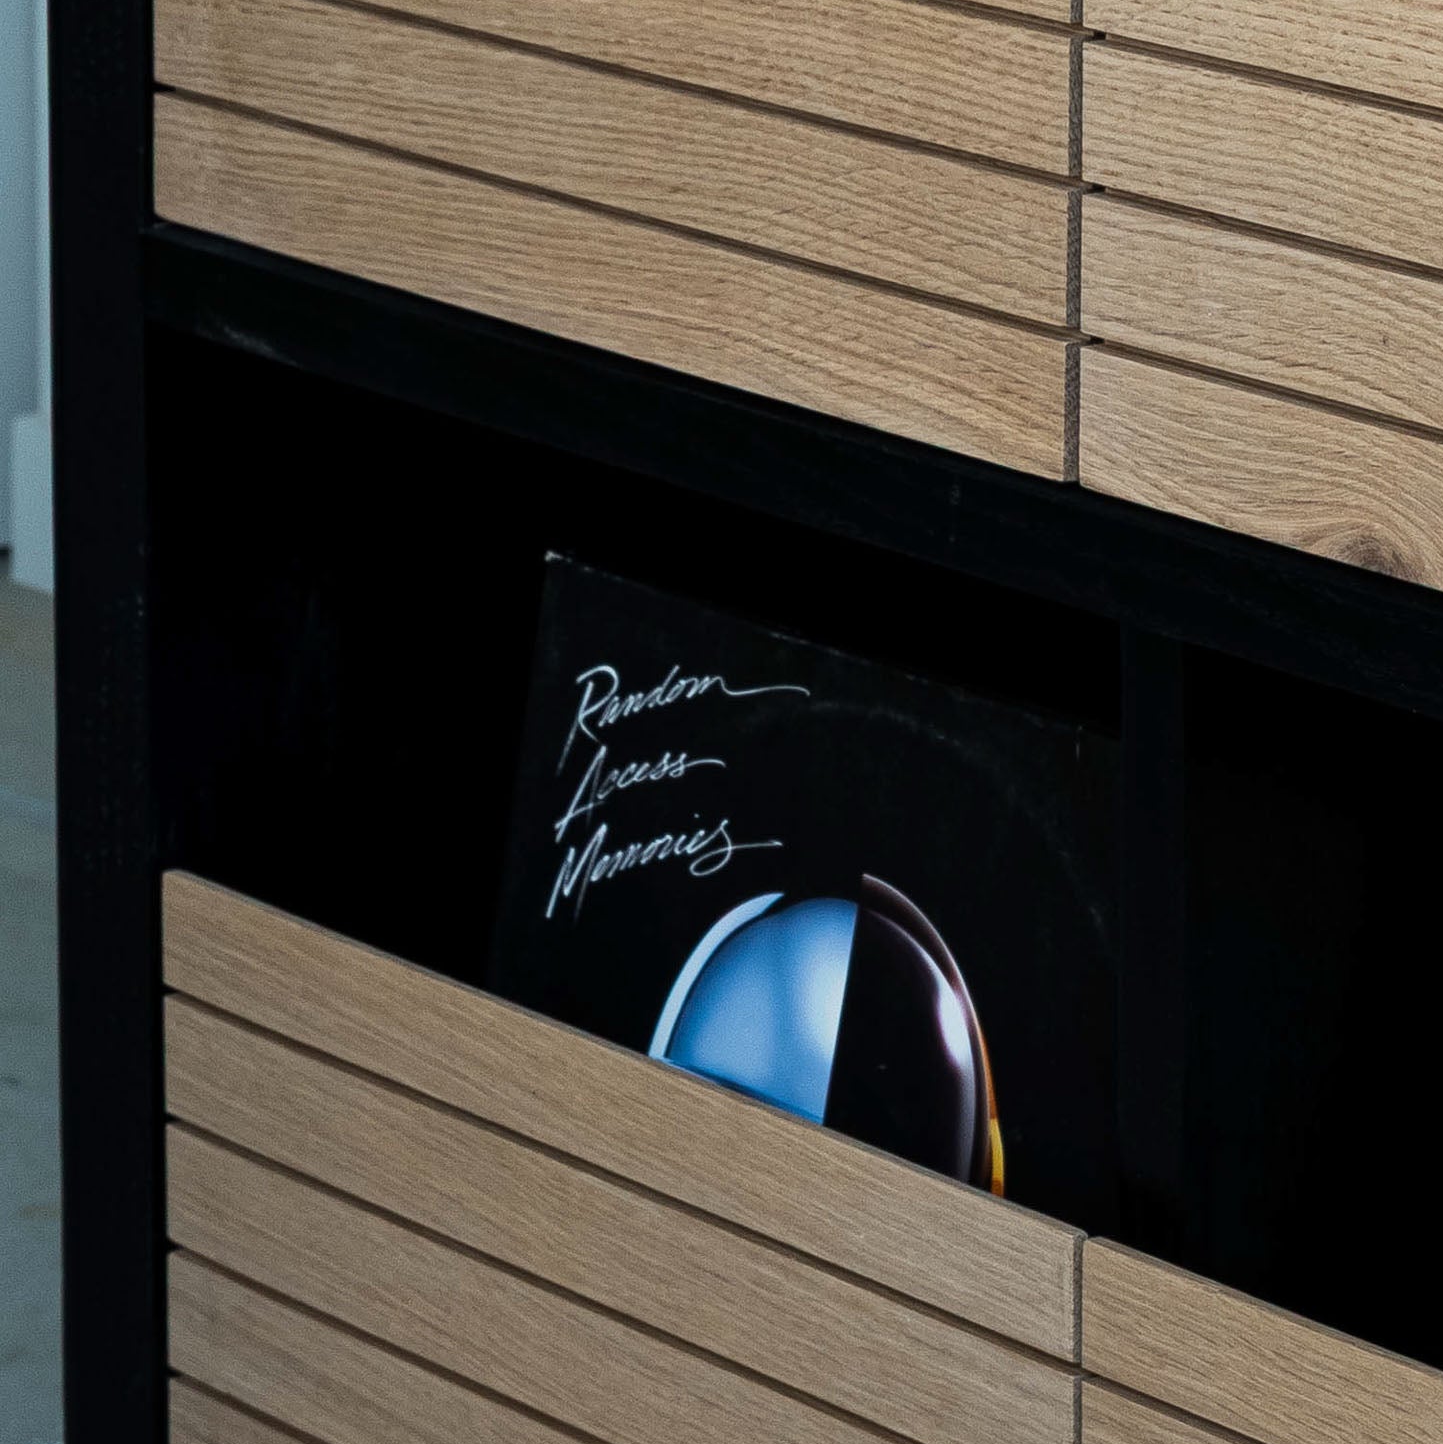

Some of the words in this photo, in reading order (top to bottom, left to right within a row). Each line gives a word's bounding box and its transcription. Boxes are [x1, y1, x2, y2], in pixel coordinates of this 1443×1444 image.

[557, 665, 810, 776] Random
[554, 745, 726, 844] Access
[546, 813, 783, 919] Memories
